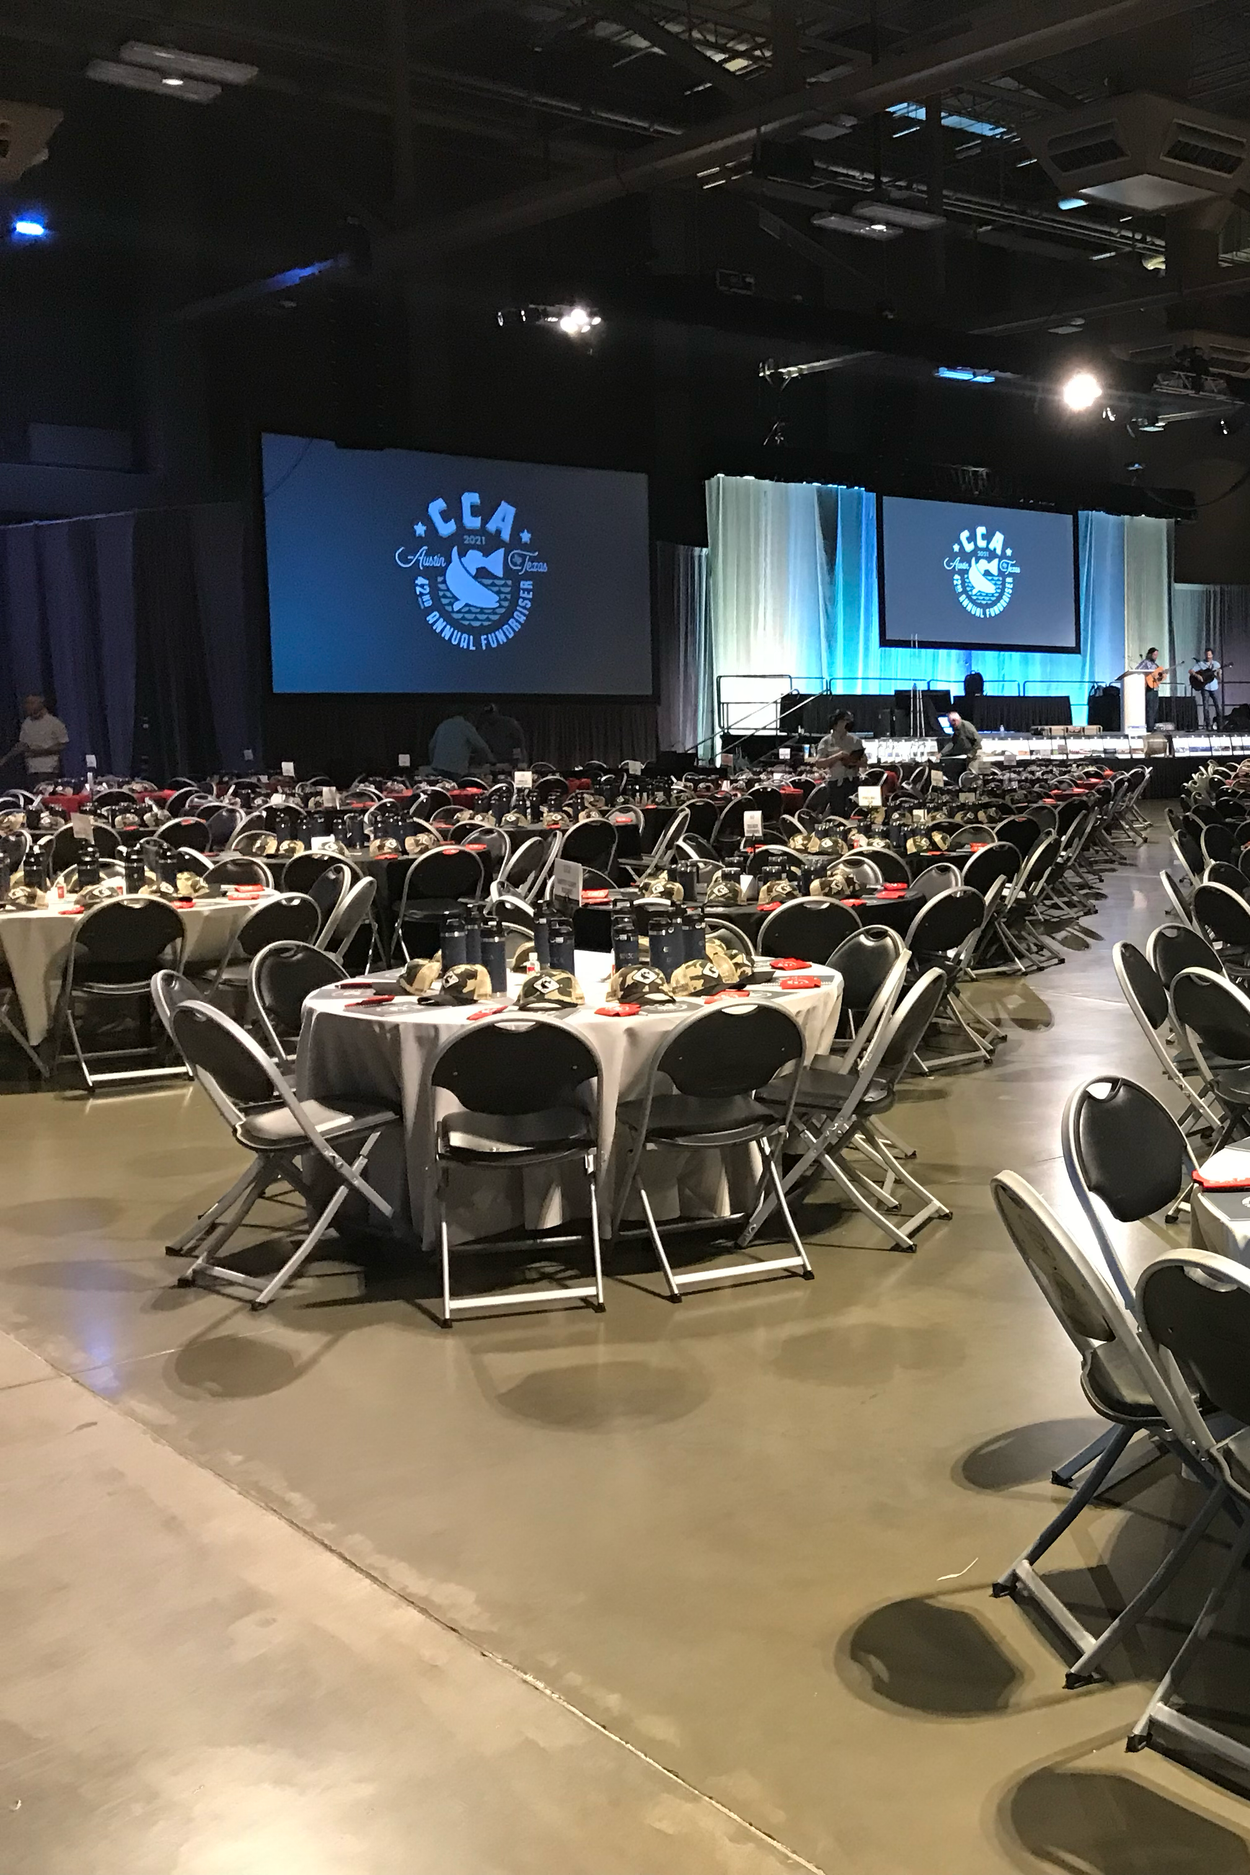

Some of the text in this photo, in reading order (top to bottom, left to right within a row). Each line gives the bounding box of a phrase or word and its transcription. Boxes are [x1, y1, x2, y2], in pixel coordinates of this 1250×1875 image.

[427, 491, 517, 543] CCA
[463, 534, 486, 546] 2021
[959, 526, 1005, 556] CCA
[395, 545, 548, 576] Austin Texas
[425, 610, 477, 651] ANNUAL
[480, 579, 534, 652] FUNDRAISER
[958, 594, 985, 619] ANNUAL
[985, 577, 1014, 618] FUNDRAISER
